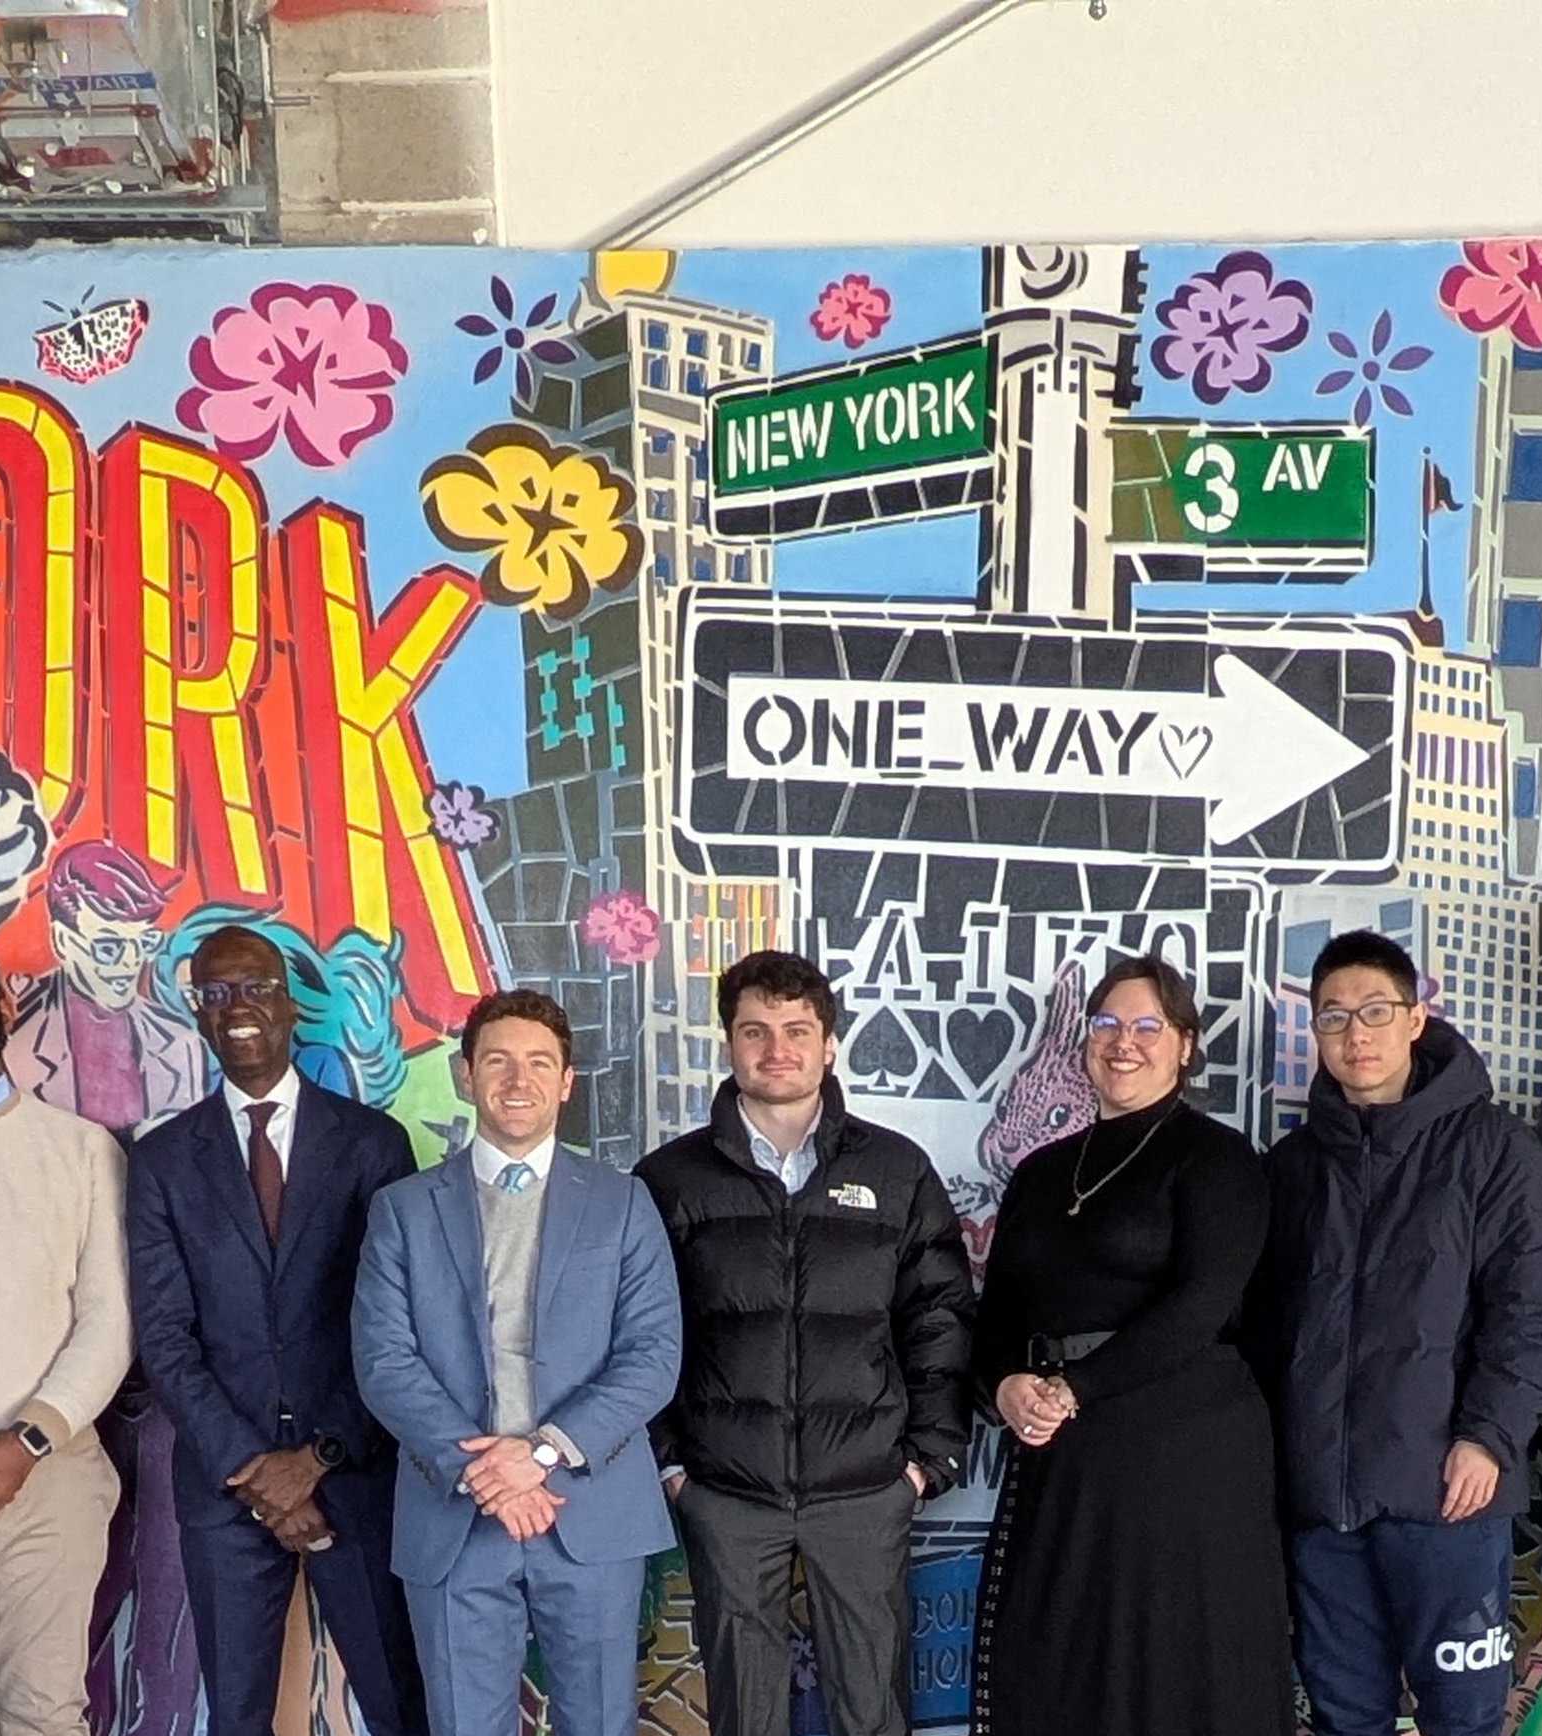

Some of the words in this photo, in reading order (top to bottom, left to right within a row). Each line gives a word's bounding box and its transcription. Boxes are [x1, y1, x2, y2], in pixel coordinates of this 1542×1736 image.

[726, 401, 835, 481] NEW
[843, 368, 977, 452] YORK
[1183, 443, 1240, 534] 3
[1261, 443, 1334, 491] AV
